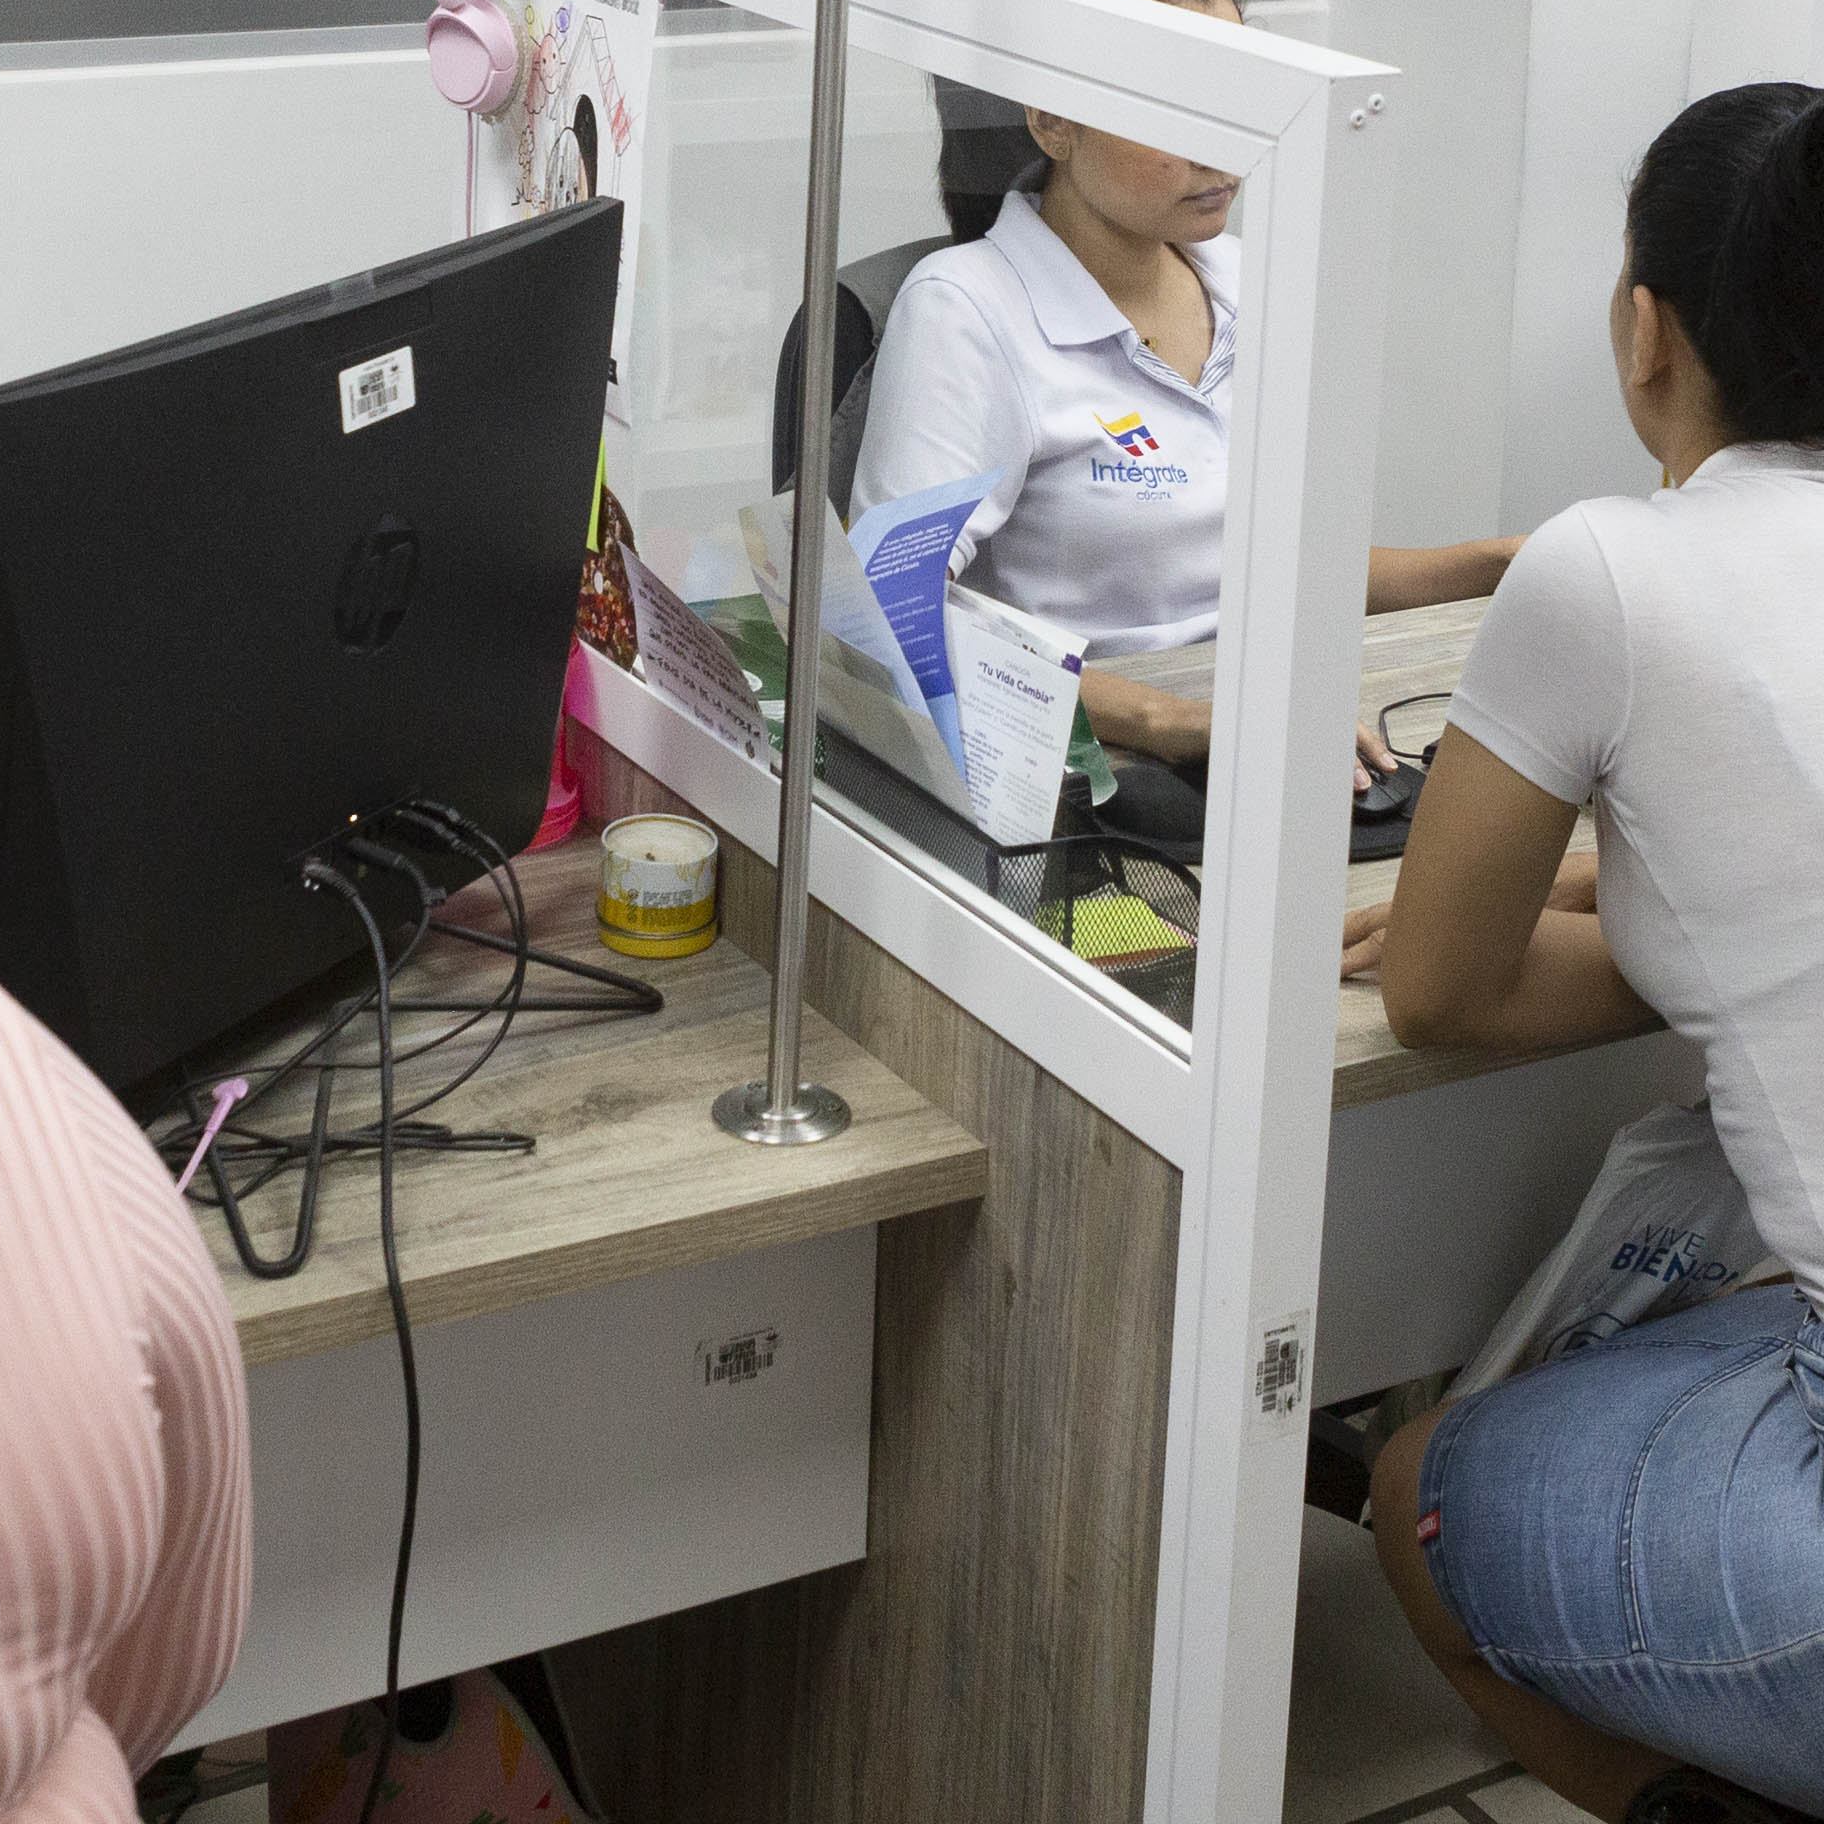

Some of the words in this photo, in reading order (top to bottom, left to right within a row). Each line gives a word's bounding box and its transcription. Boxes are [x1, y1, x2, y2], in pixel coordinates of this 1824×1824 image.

[1091, 457, 1189, 489] Intégrate
[996, 668, 1015, 688] Vida
[1643, 1223, 1705, 1258] VIVE
